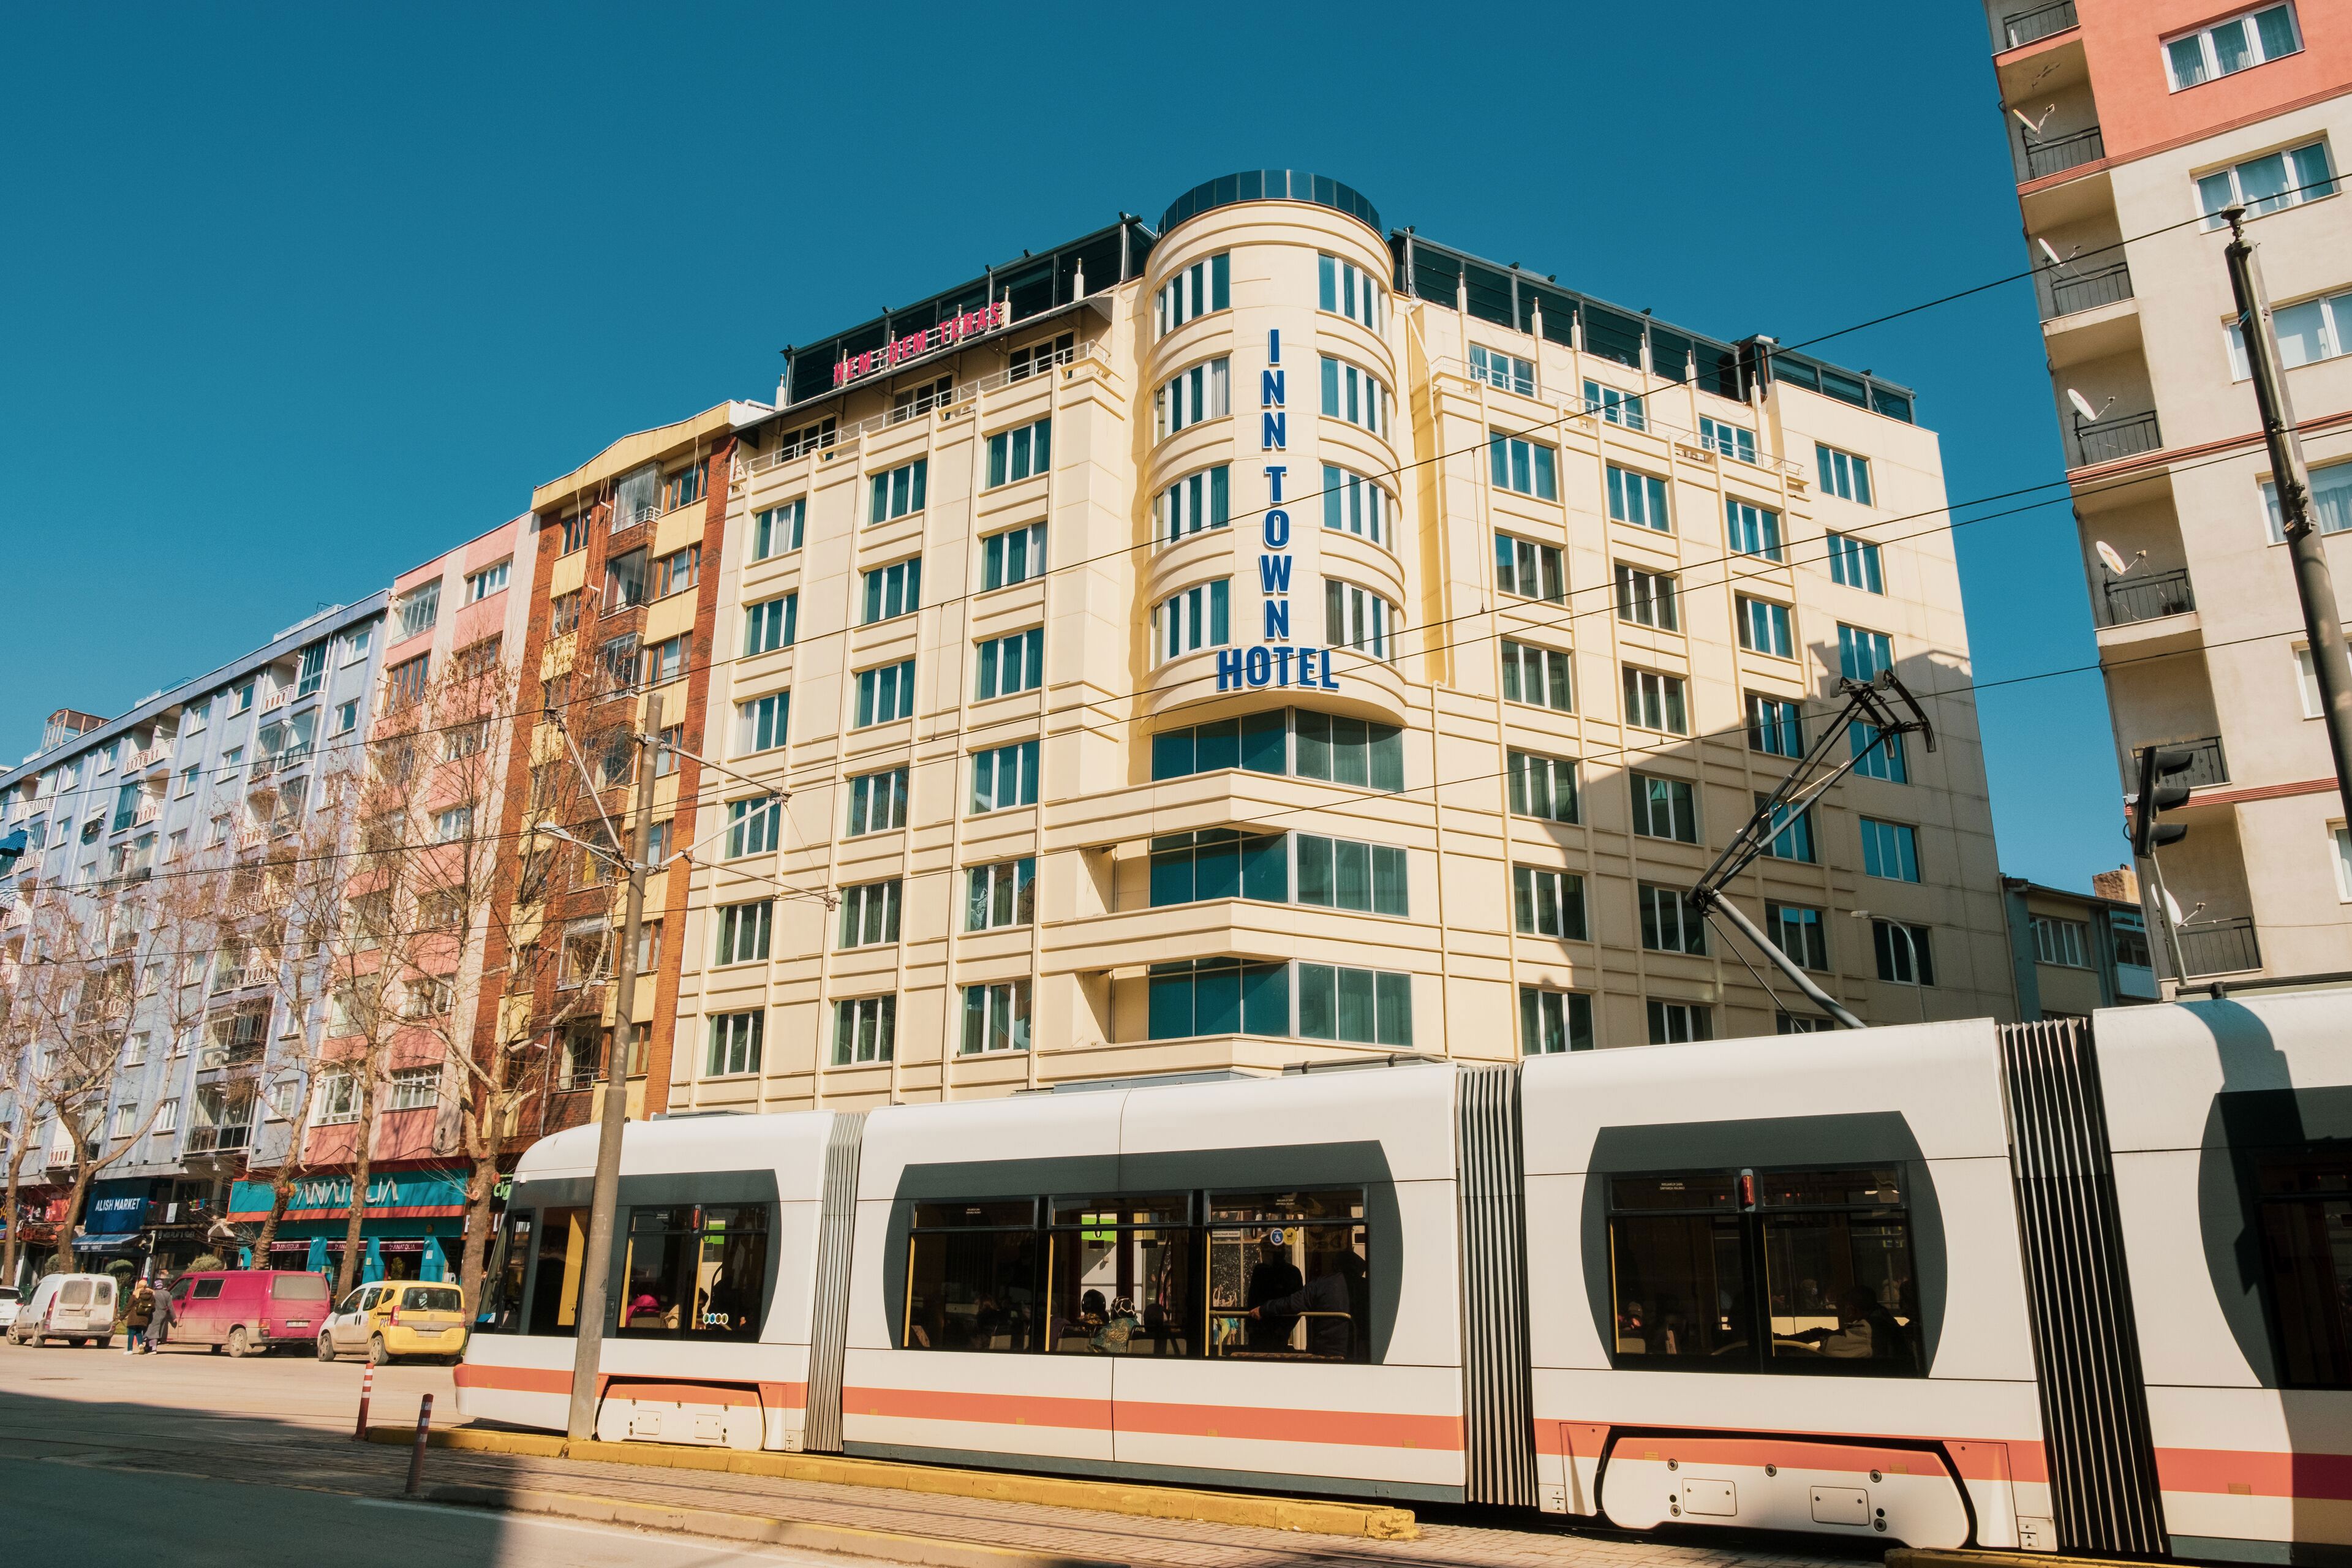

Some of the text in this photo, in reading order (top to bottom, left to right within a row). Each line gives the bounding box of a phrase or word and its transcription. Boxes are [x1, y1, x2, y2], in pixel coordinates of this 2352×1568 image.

[938, 302, 1001, 344] TERAS
[1259, 328, 1292, 639] INN TOWN
[1218, 646, 1340, 691] HOTEL
[95, 1198, 141, 1212] ALISH MARKET
[296, 1178, 399, 1206] ANATLIA
